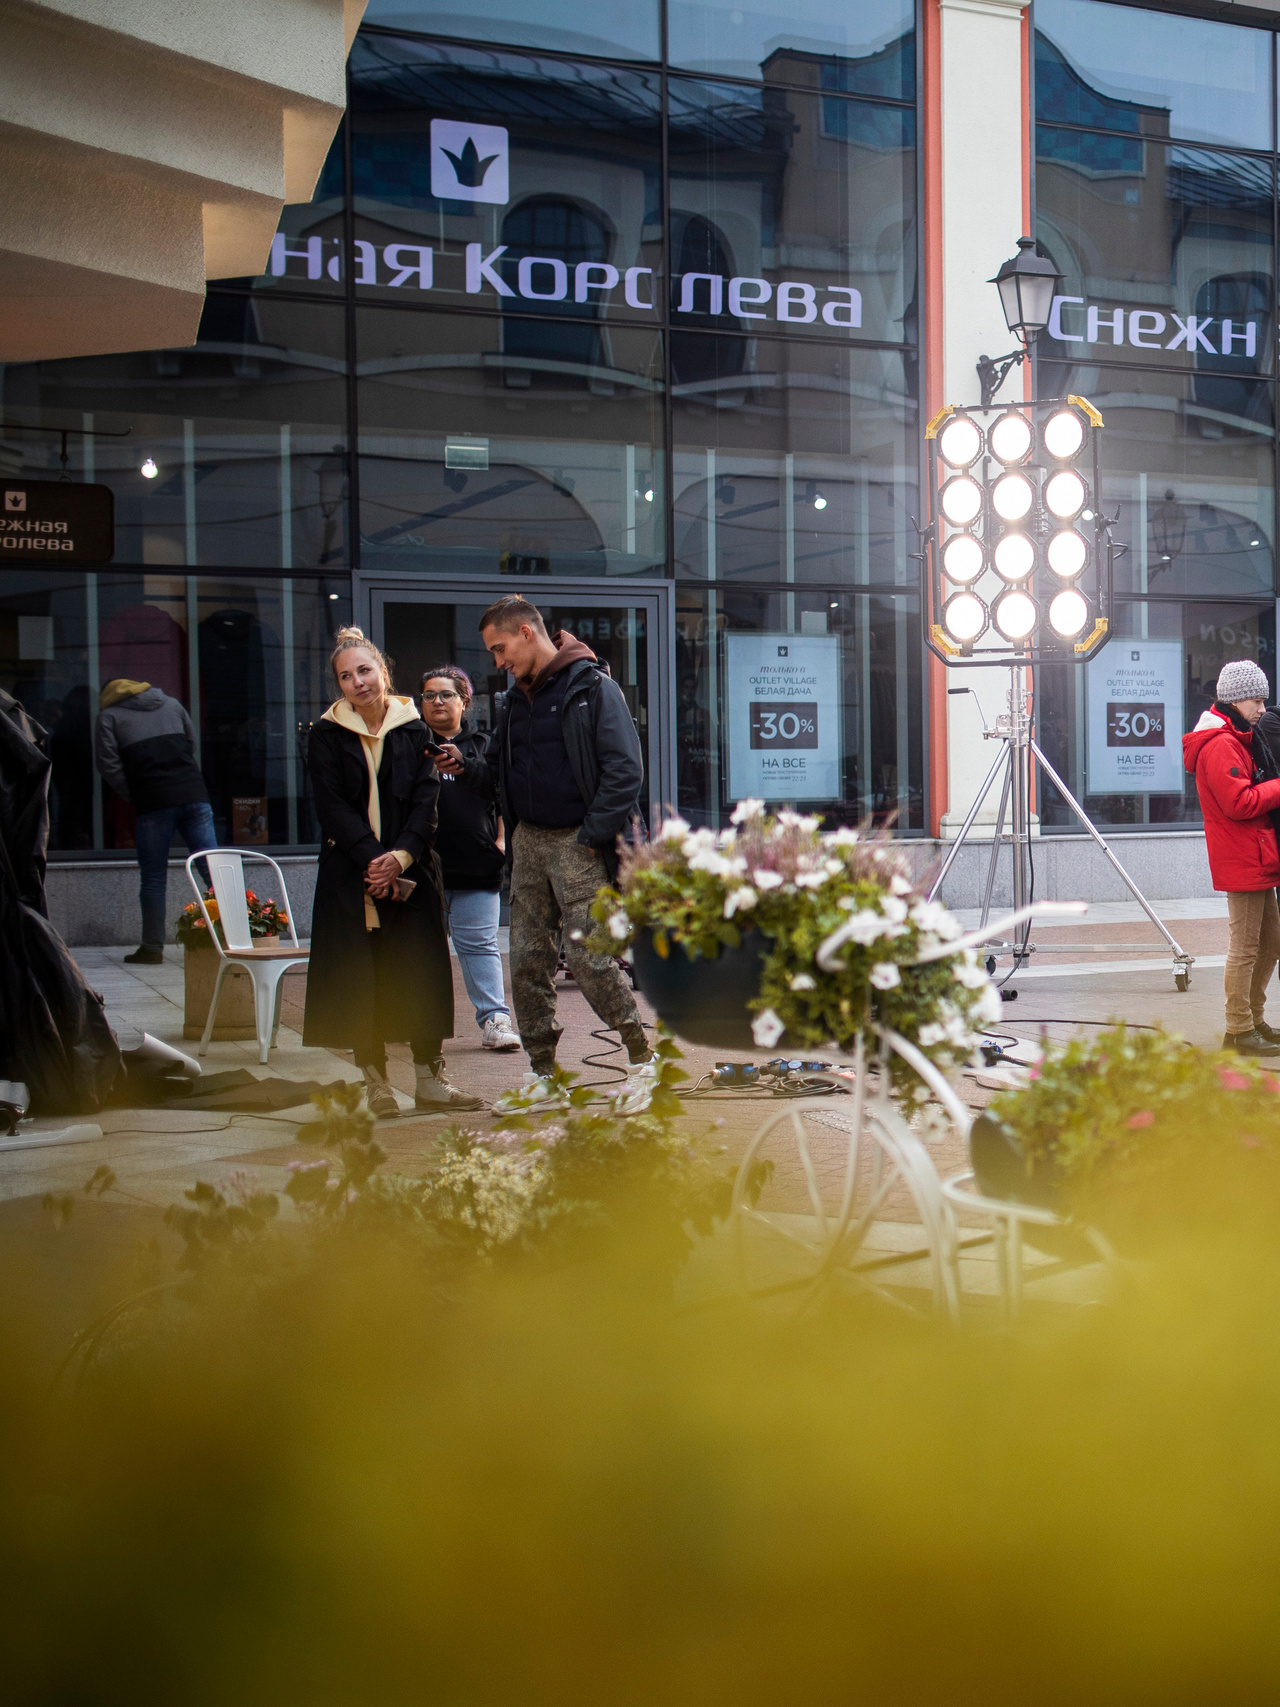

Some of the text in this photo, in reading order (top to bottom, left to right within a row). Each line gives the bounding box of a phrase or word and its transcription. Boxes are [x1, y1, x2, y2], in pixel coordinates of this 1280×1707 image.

[0, 537, 74, 551] олева
[749, 676, 817, 685] OUTLET VILLAGE
[1106, 679, 1165, 687] OUTLET VILLAGE
[755, 687, 812, 696] БЕЛАЯ ДАЧА
[1111, 688, 1160, 697] БЕЛАЯ ДАЧА
[753, 712, 814, 739] -30%
[1109, 712, 1162, 738] -30%
[762, 758, 806, 768] НА ВСЕ
[1117, 755, 1155, 764] НА ВСЕ
